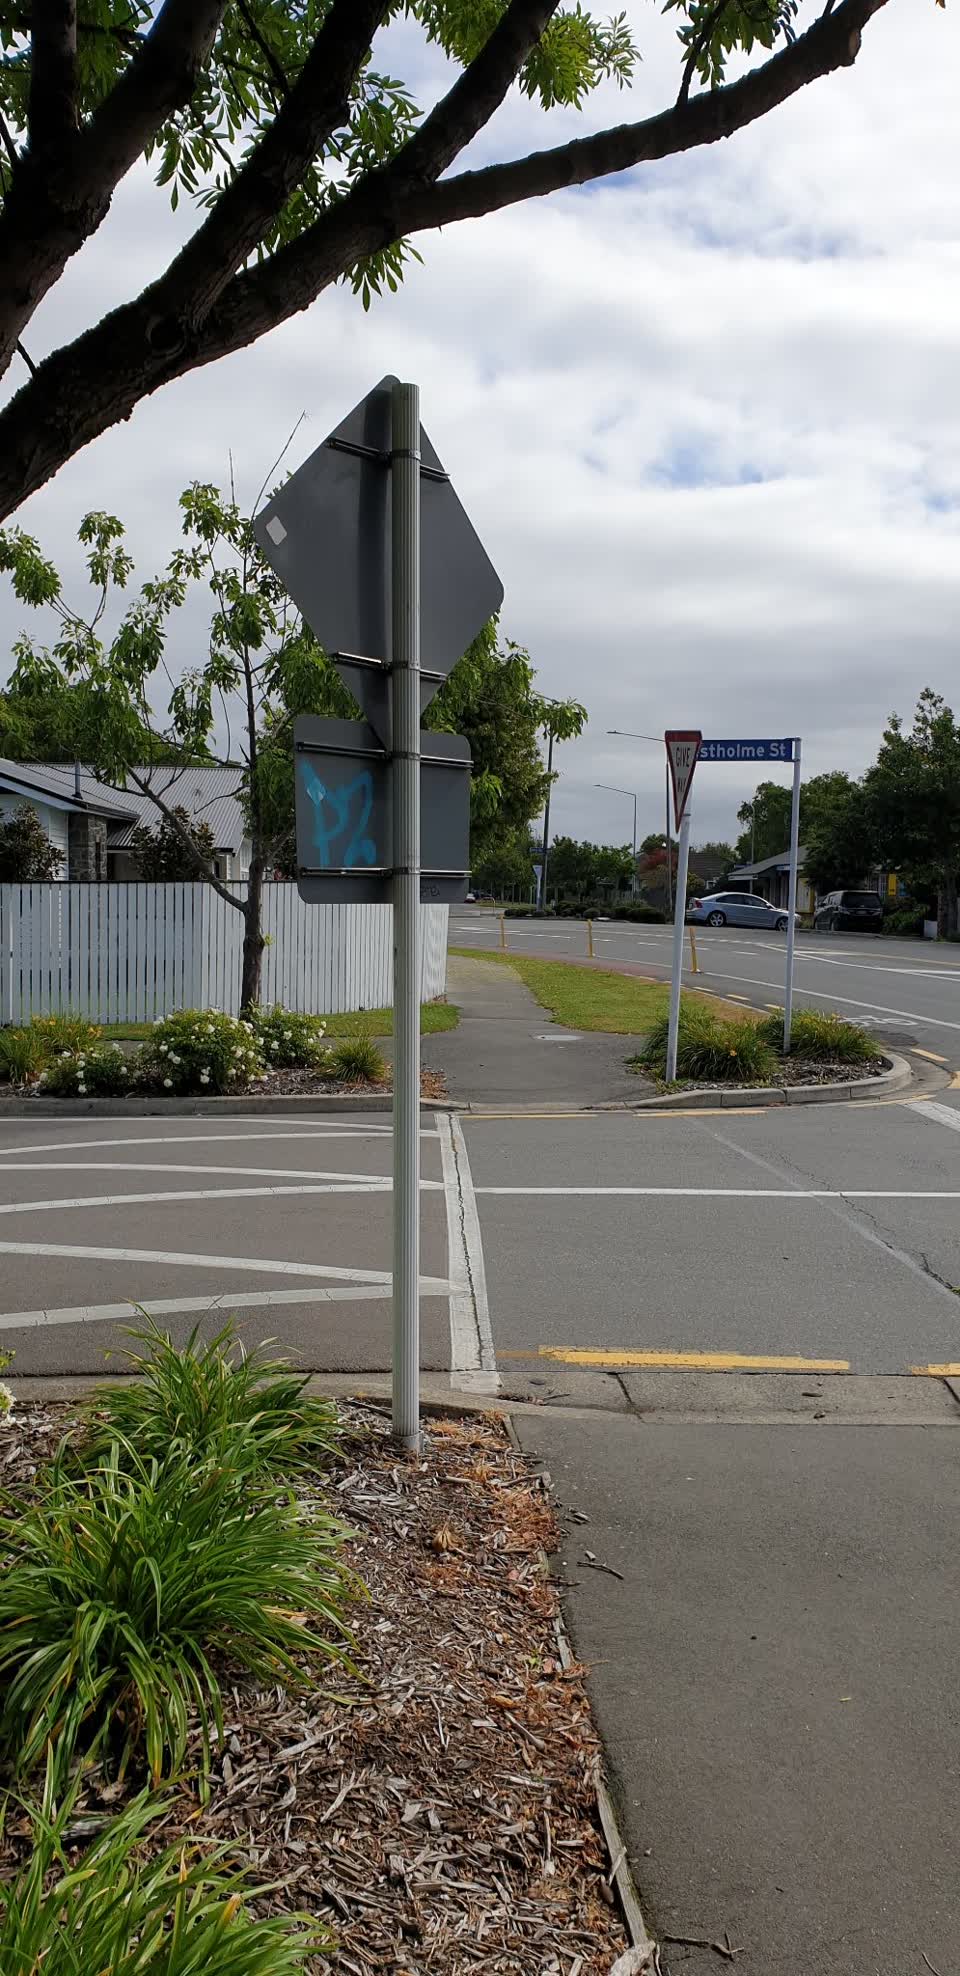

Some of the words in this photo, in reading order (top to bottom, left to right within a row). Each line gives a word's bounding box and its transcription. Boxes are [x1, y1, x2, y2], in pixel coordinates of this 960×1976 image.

[675, 747, 691, 768] GIVE
[696, 743, 766, 758] stholme
[769, 742, 786, 757] St
